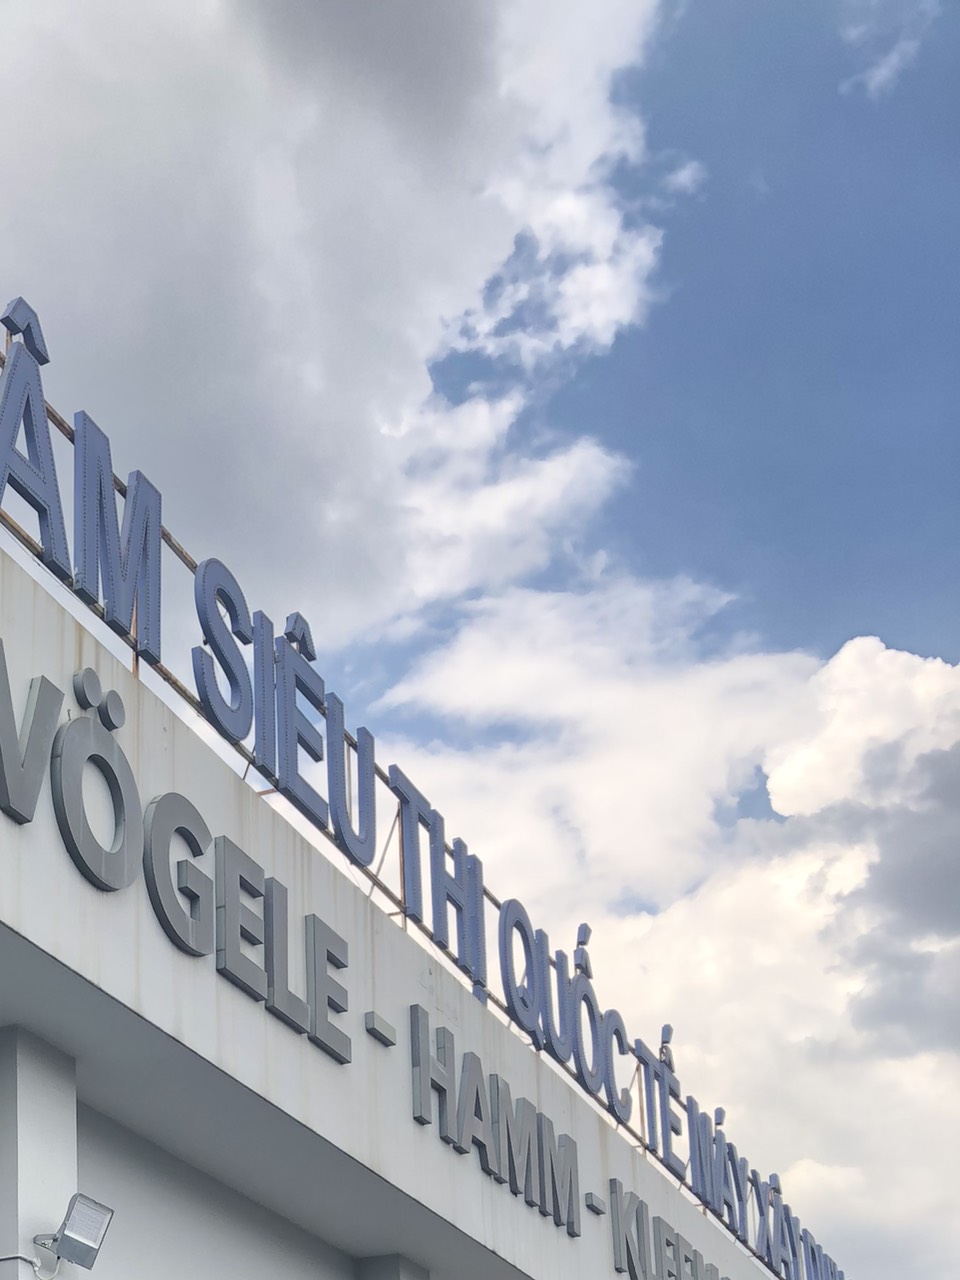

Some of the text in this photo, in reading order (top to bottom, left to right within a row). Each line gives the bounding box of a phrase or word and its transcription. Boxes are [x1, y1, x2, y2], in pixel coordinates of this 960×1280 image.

[192, 558, 376, 867] SIÊU
[498, 898, 633, 1125] QUỐC
[635, 1024, 686, 1182] TẾ
[685, 1095, 749, 1245] MÁY
[410, 1004, 581, 1238] HAMM
